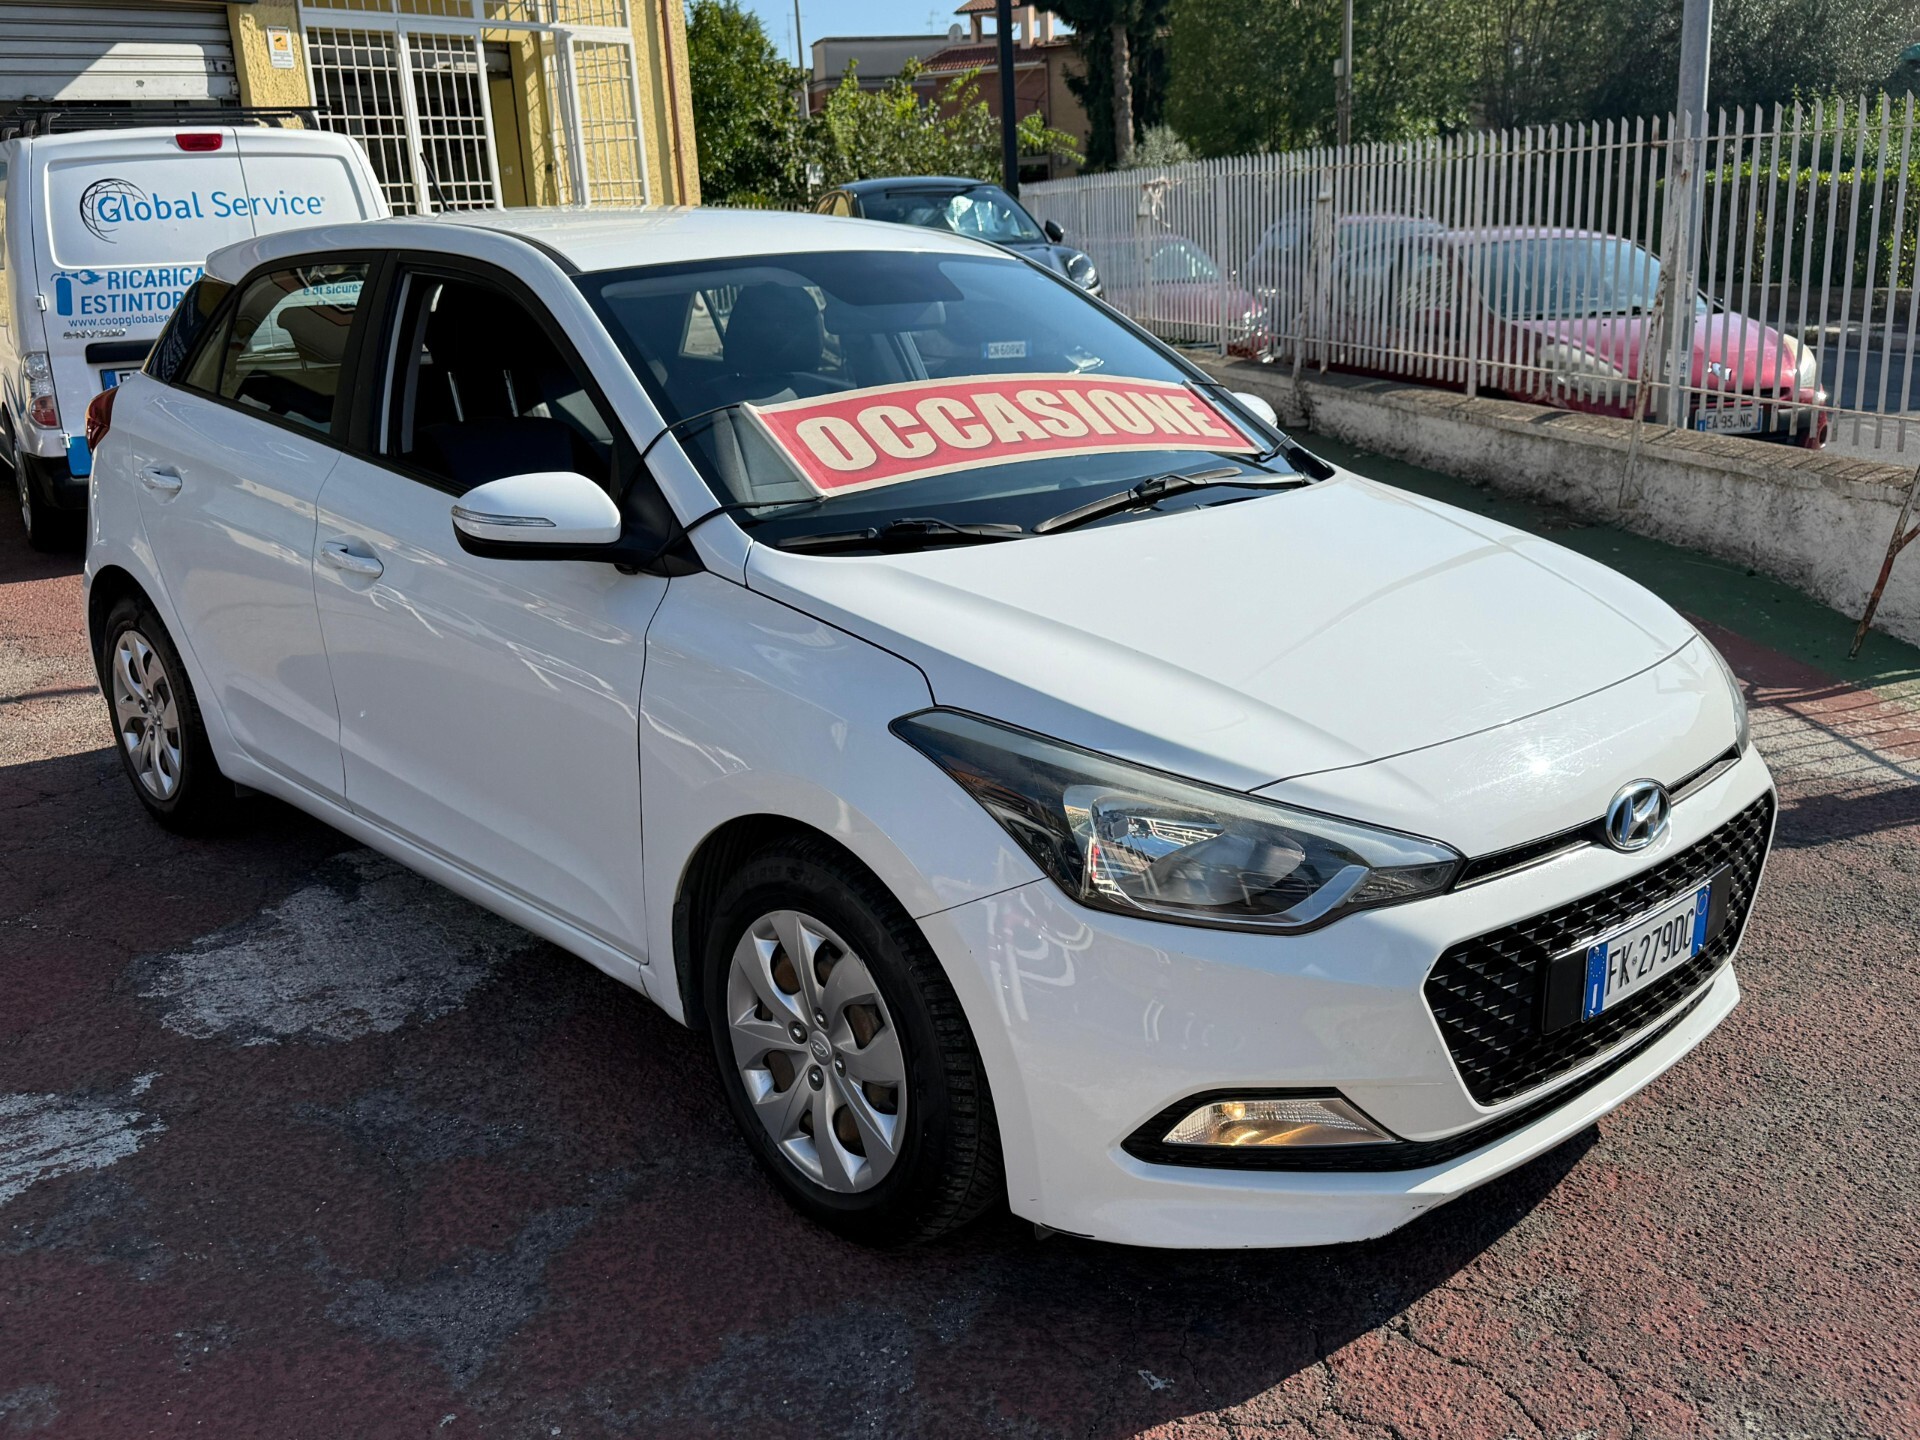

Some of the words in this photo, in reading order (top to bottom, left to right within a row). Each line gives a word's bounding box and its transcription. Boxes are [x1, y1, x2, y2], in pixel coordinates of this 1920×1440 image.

[98, 191, 204, 223] Global
[211, 190, 323, 218] Service
[325, 283, 361, 295] sicure
[796, 388, 1229, 472] OCCASIONE
